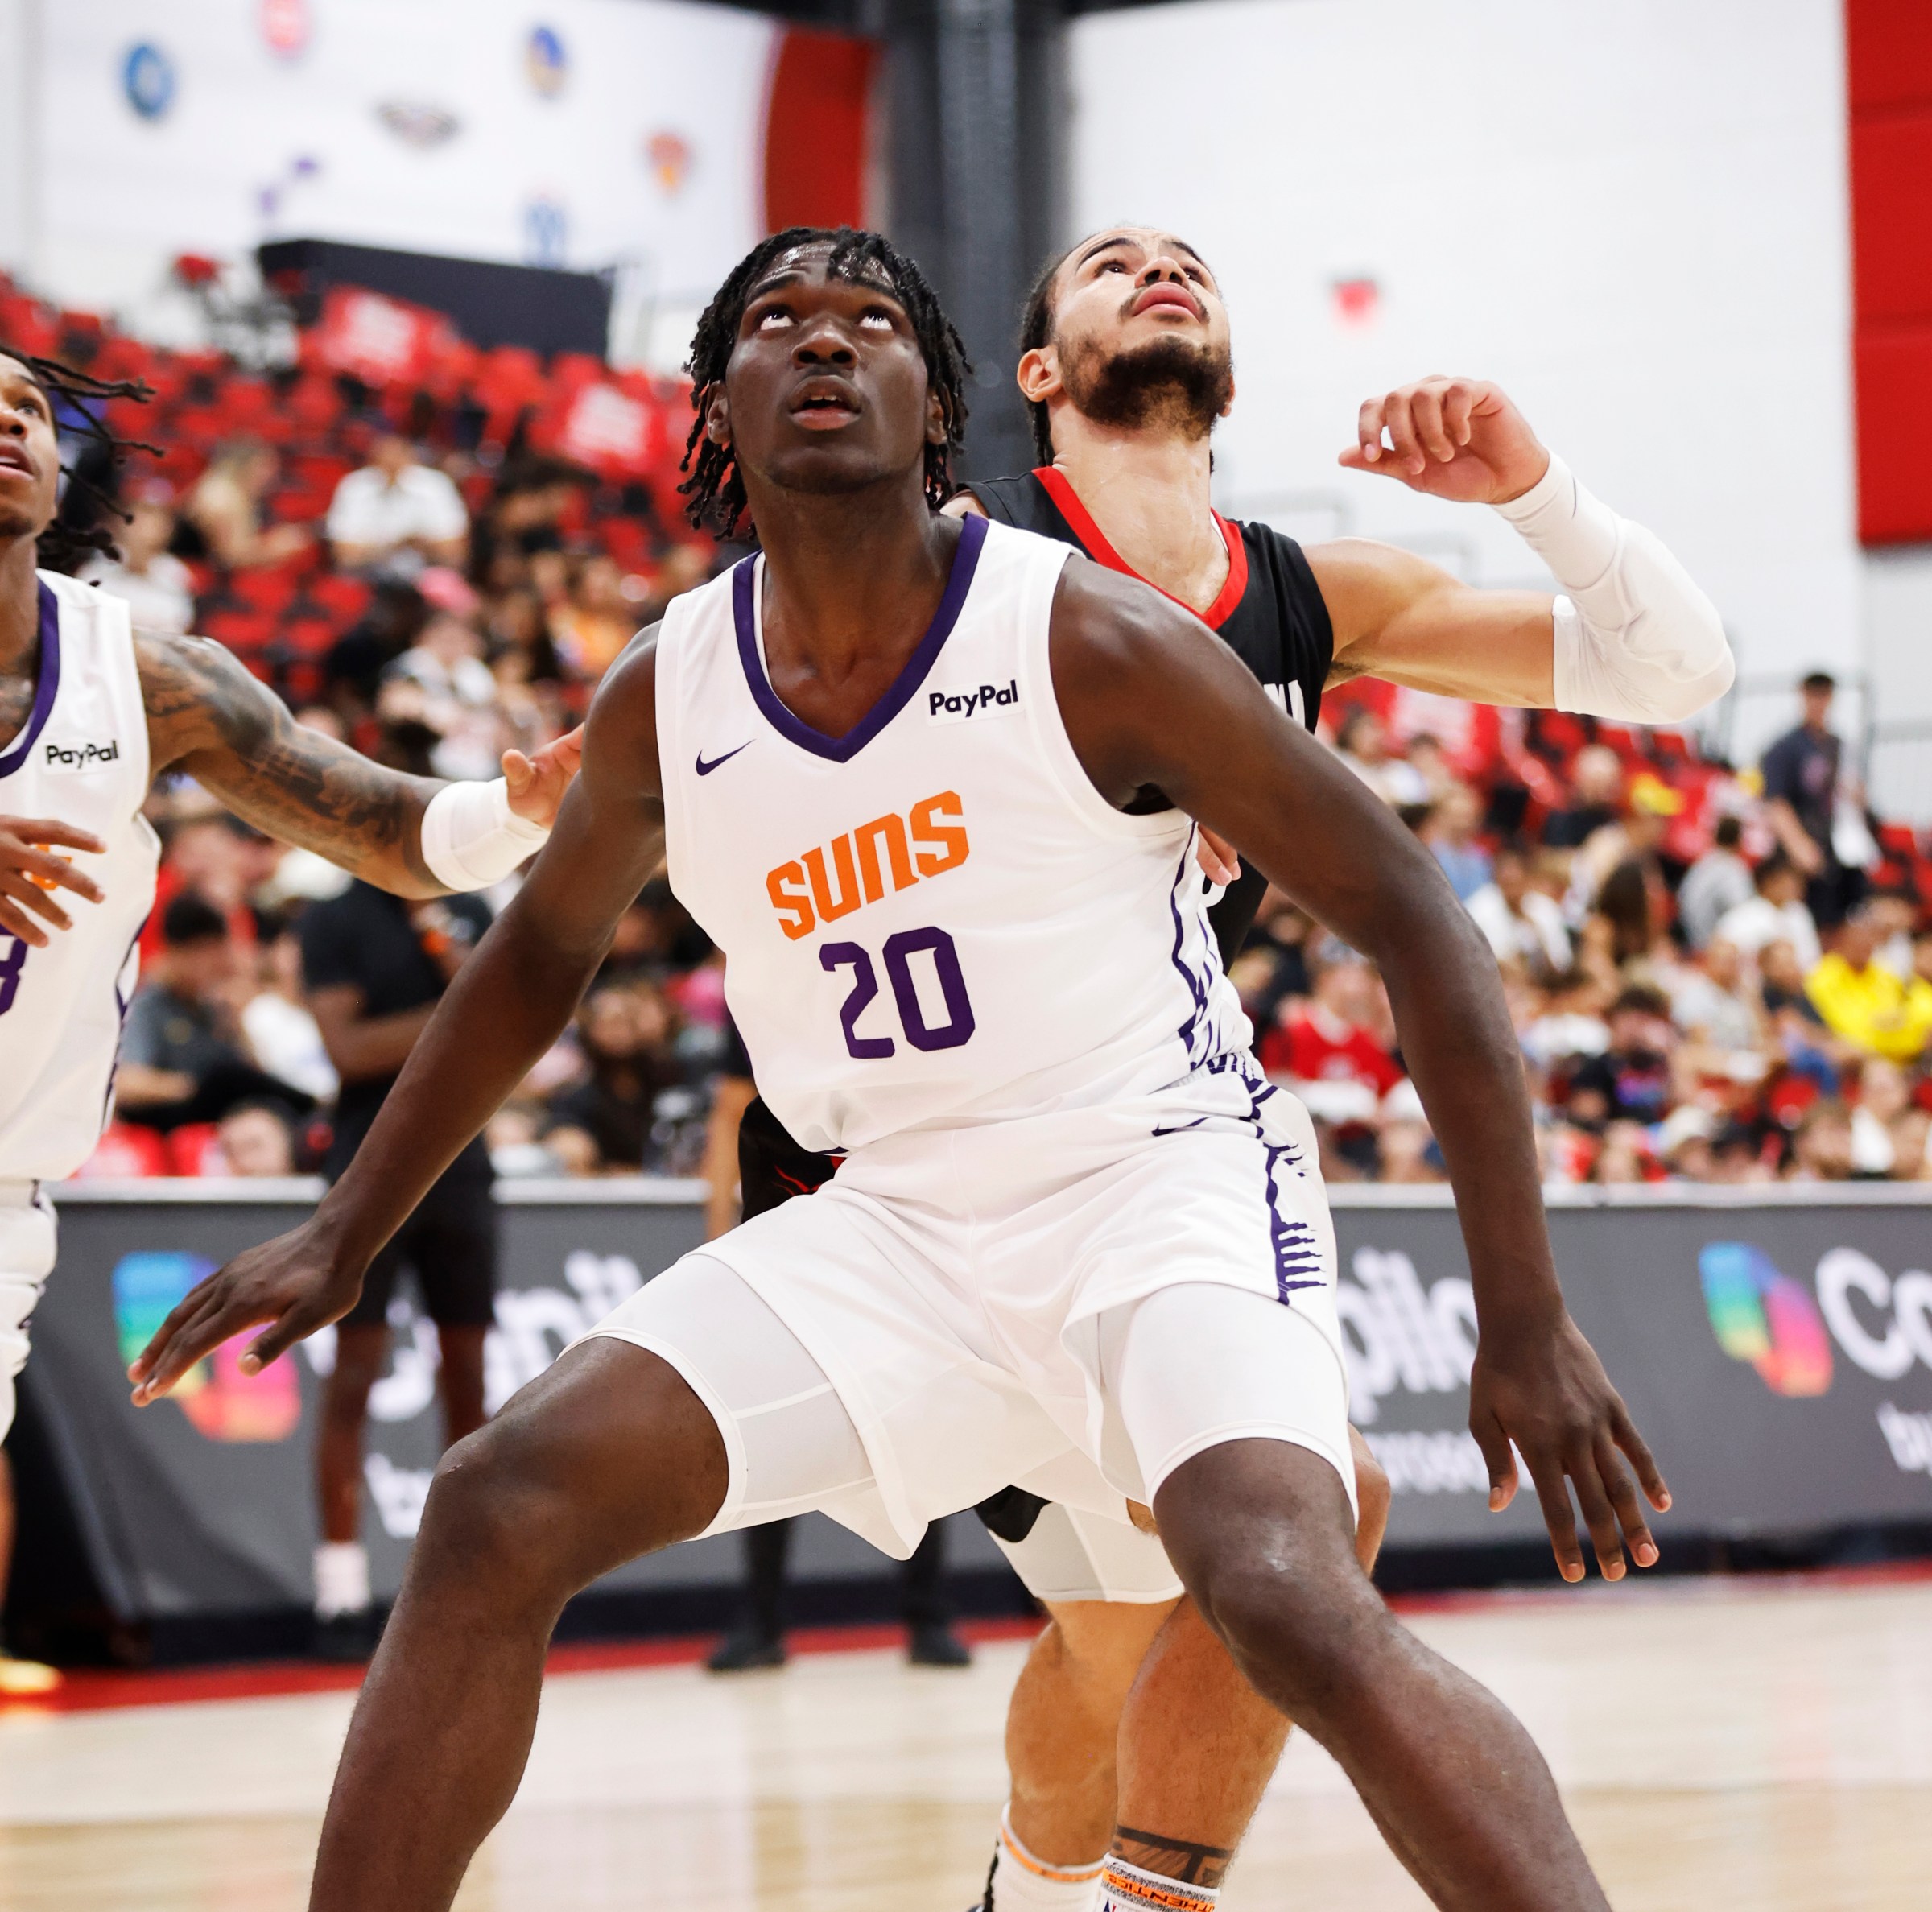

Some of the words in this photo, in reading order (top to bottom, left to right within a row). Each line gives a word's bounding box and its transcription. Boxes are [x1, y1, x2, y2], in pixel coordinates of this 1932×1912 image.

[929, 679, 1018, 718] PayPal
[46, 739, 118, 769] PayPal
[766, 790, 970, 941] SUNS
[819, 926, 976, 1059] 20
